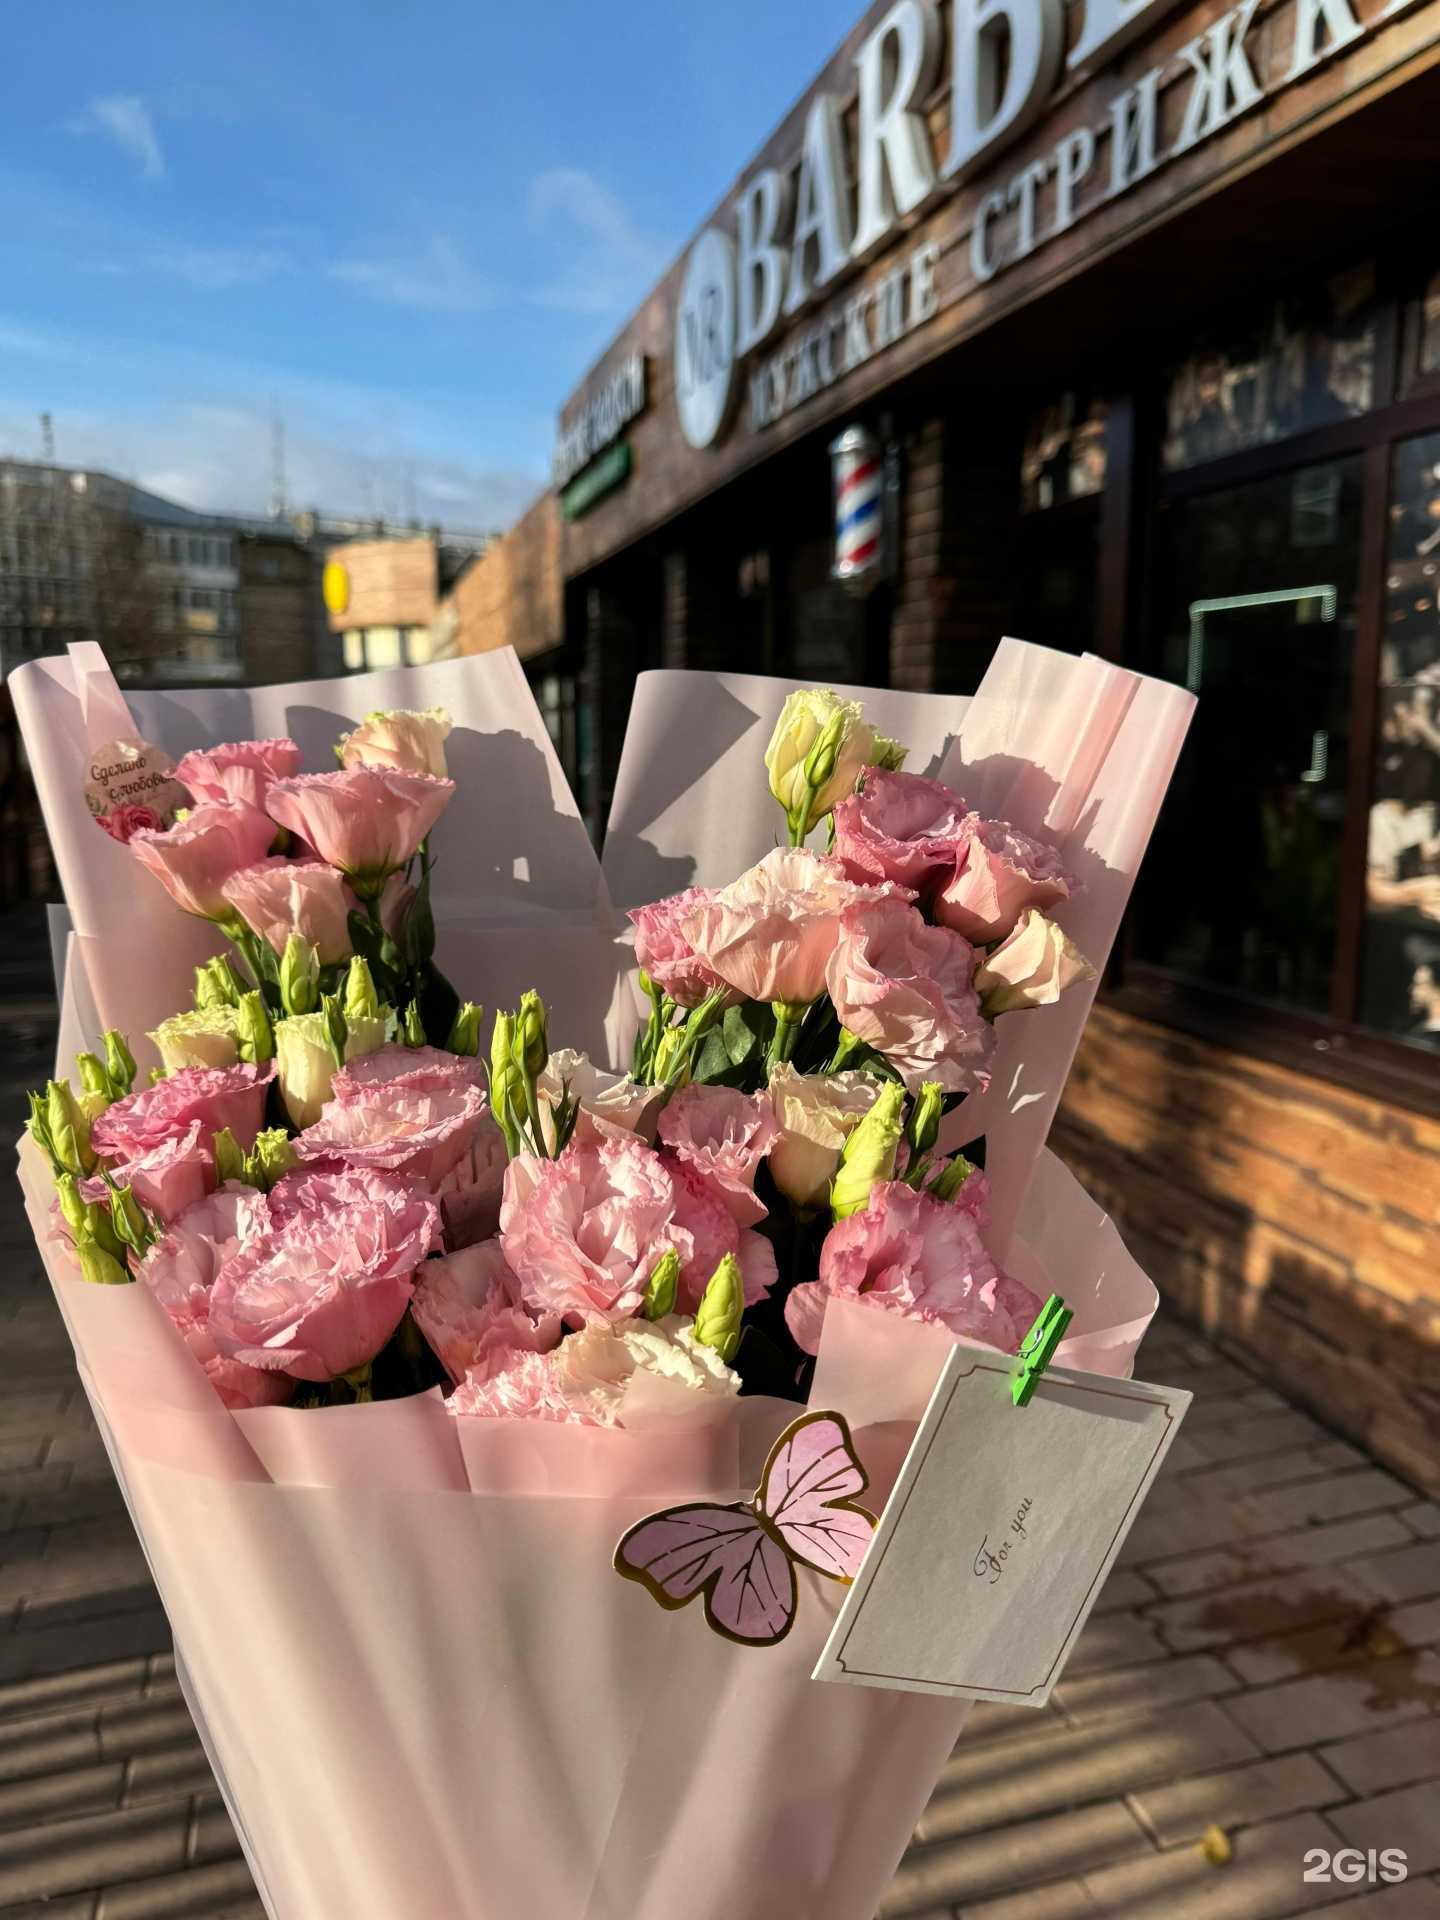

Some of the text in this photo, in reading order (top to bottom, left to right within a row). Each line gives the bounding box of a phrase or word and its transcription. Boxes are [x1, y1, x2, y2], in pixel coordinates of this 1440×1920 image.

[735, 0, 1158, 358] BARB
[90, 757, 147, 787] Сделано
[973, 1497, 1033, 1585] For you
